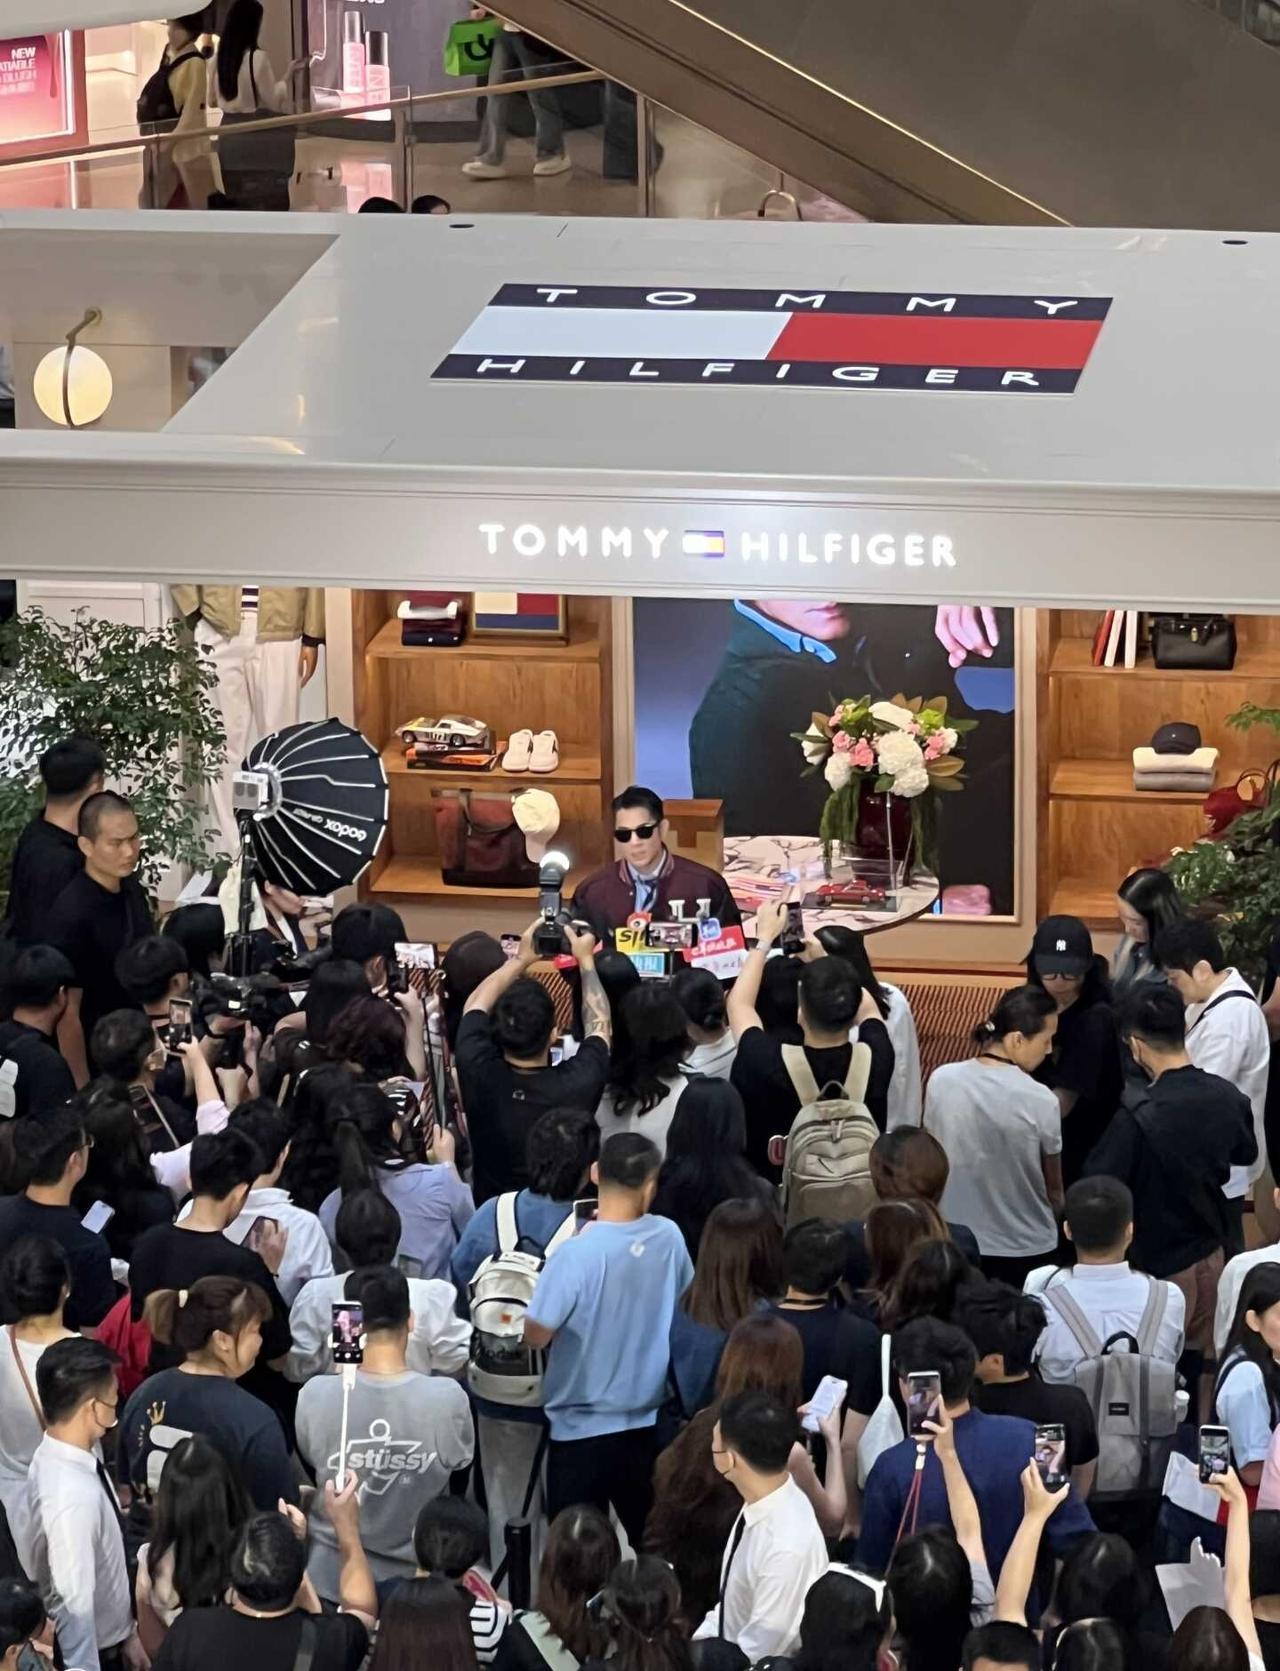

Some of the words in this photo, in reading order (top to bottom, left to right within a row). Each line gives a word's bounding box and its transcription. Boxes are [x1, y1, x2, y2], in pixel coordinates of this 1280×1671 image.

[11, 47, 36, 59] NEW
[536, 288, 1078, 315] TOMMY
[476, 358, 1040, 386] HILFIGER
[479, 523, 669, 559] TOMMY
[741, 531, 957, 567] HILFIGER
